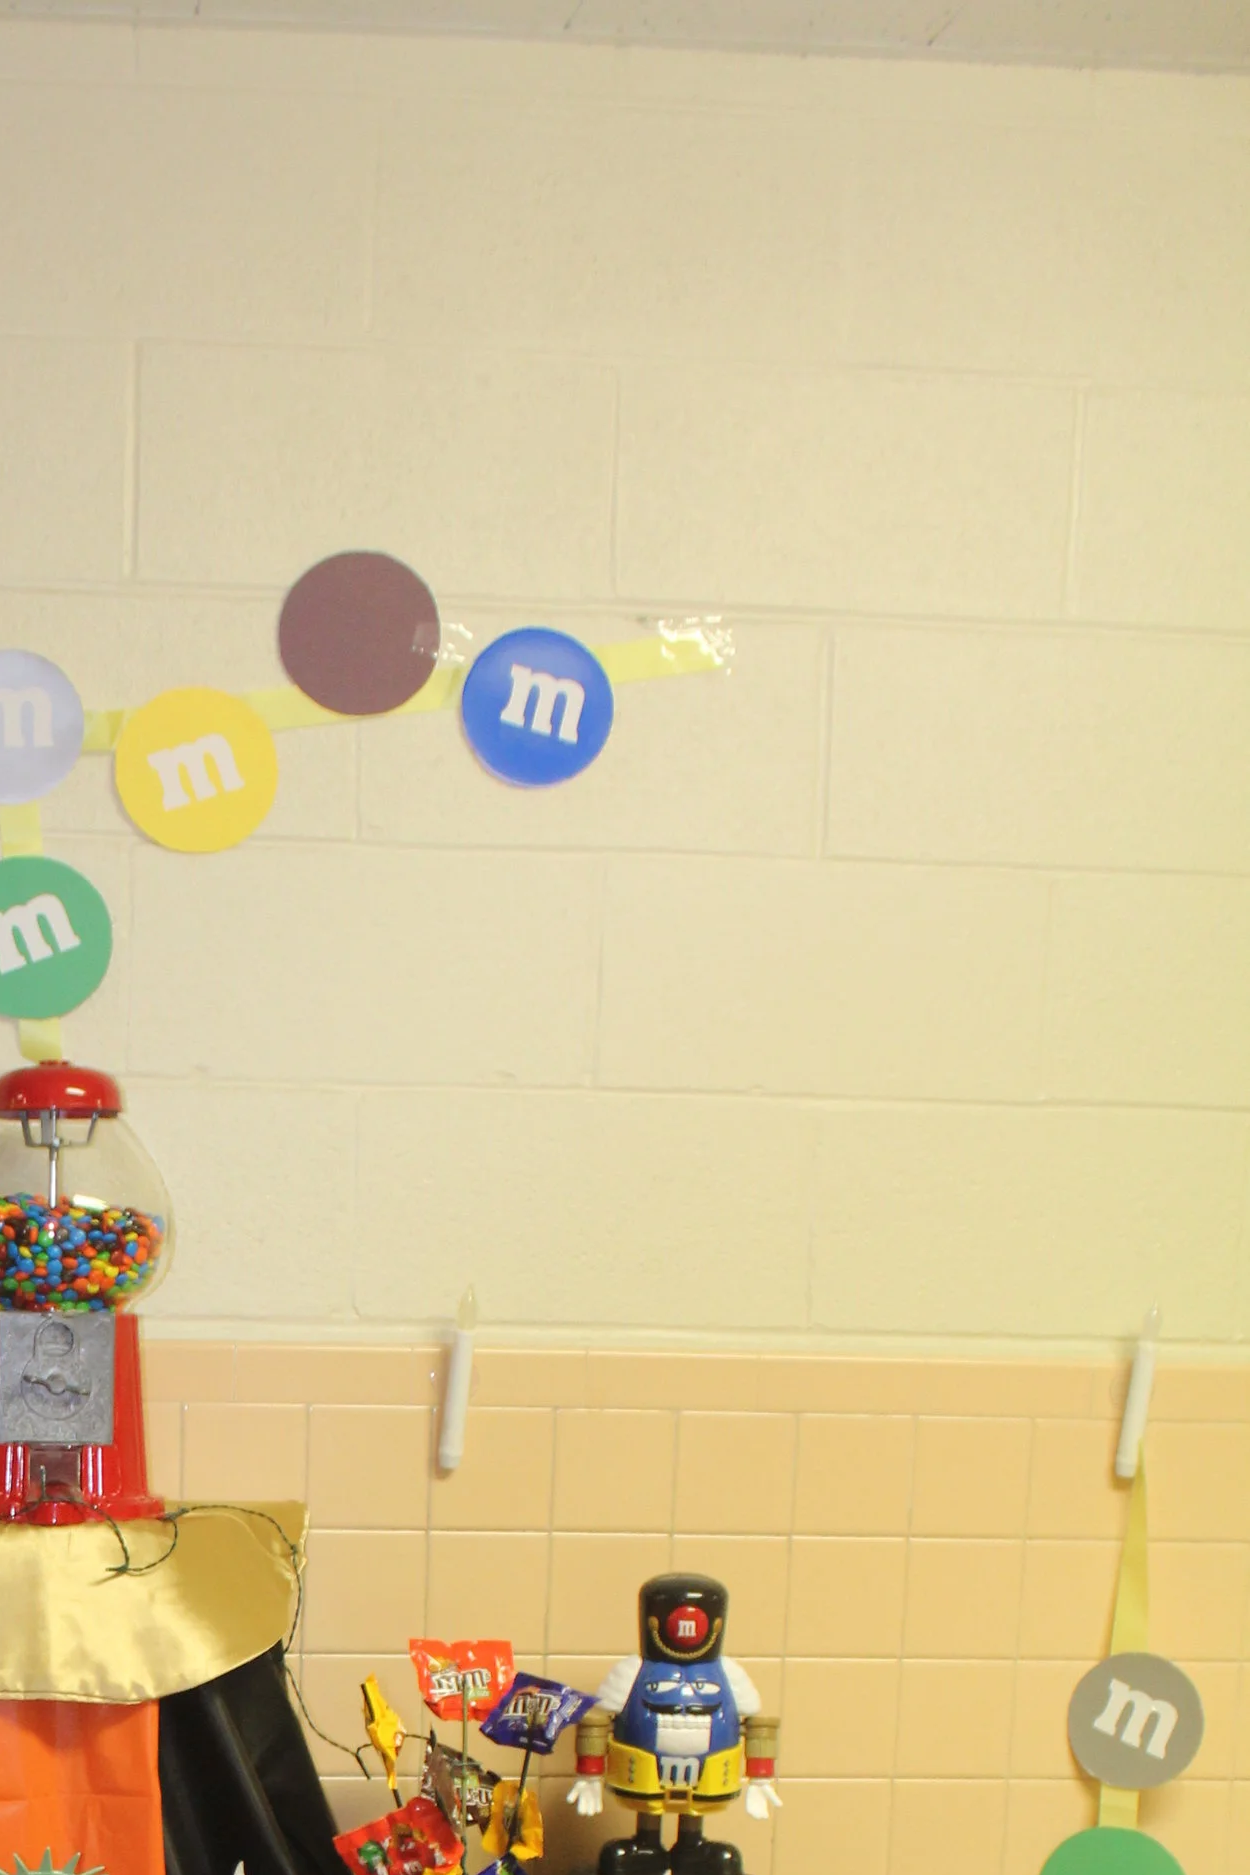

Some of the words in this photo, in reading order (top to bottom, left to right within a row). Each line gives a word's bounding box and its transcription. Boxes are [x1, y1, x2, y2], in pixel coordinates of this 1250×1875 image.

[500, 663, 585, 744] m
[147, 734, 244, 812] m
[1093, 1678, 1178, 1759] m
[660, 1756, 700, 1786] m
